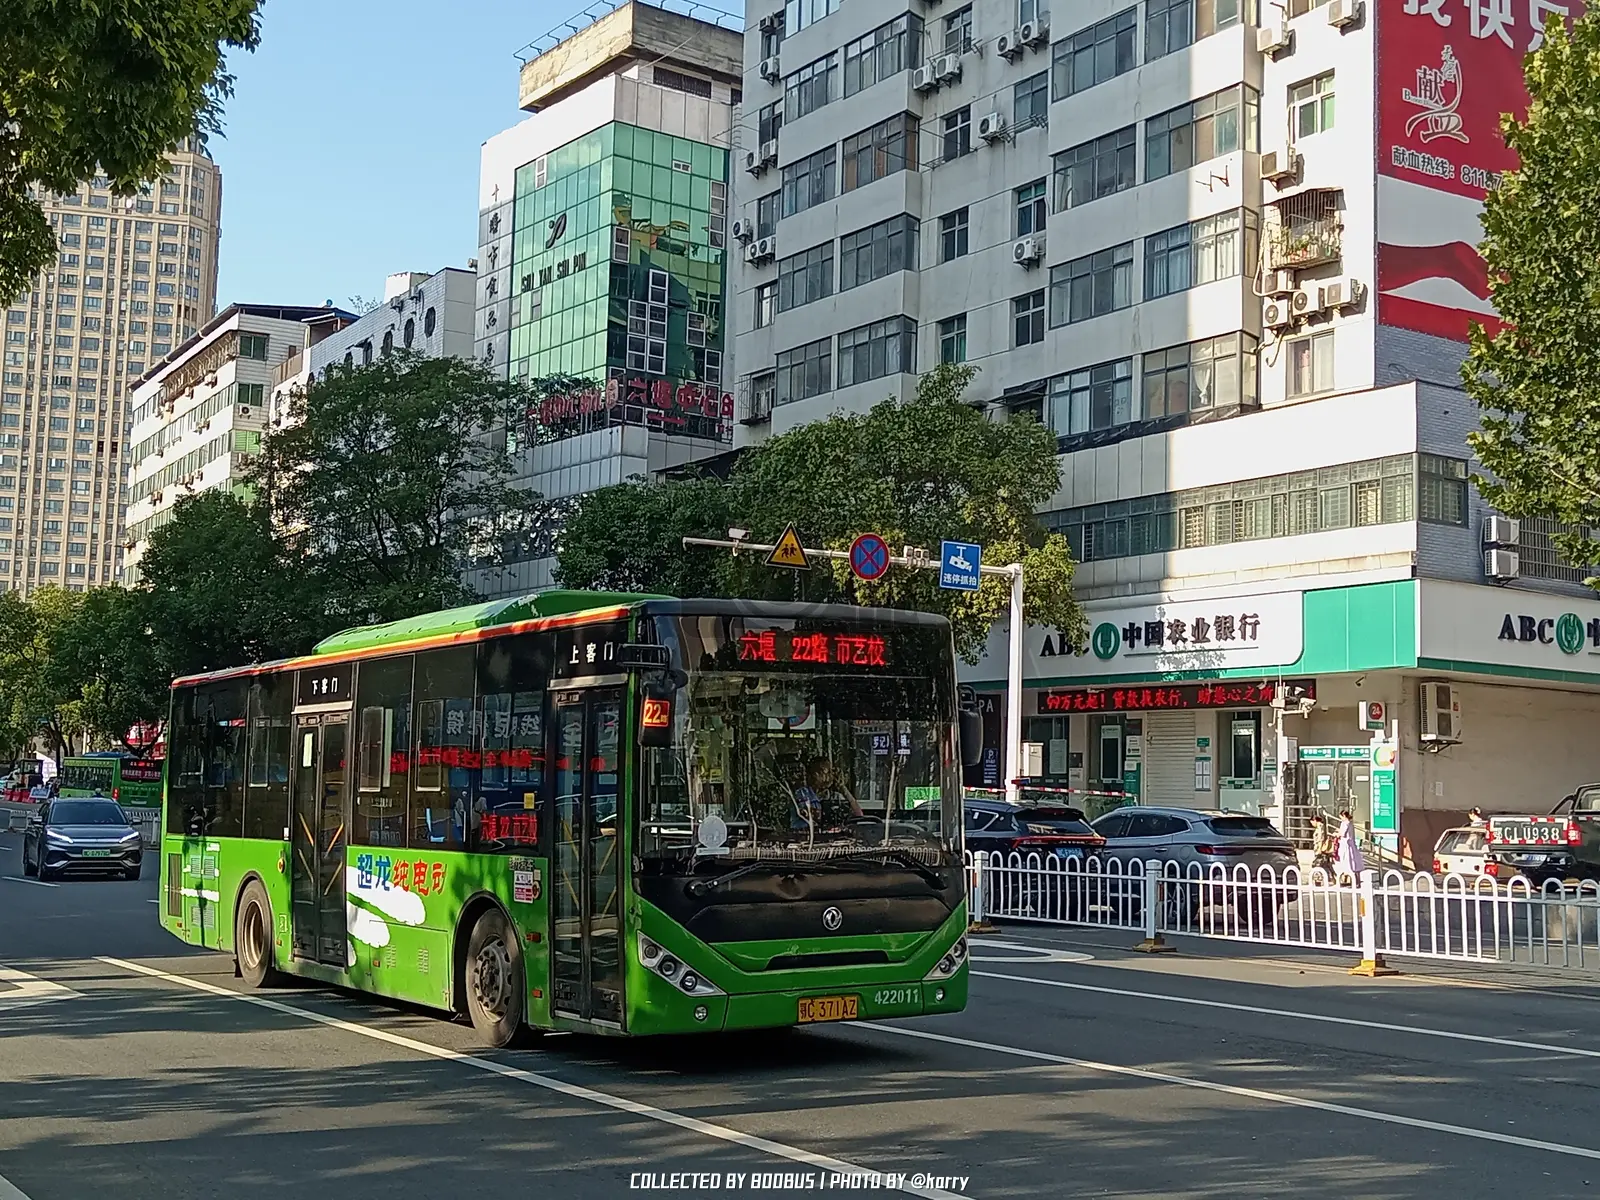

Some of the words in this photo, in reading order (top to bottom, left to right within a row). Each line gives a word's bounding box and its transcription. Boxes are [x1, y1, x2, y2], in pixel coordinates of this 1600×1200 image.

[943, 573, 977, 586] 违停抓拍
[1122, 613, 1261, 649] 中国农业银行
[1497, 613, 1554, 644] ABC
[569, 641, 614, 664] 上客门
[740, 630, 776, 662] 六堰
[792, 632, 829, 664] 22路
[834, 633, 886, 666] 市艺校
[312, 677, 338, 695] 下客门
[874, 988, 919, 1005] 422011
